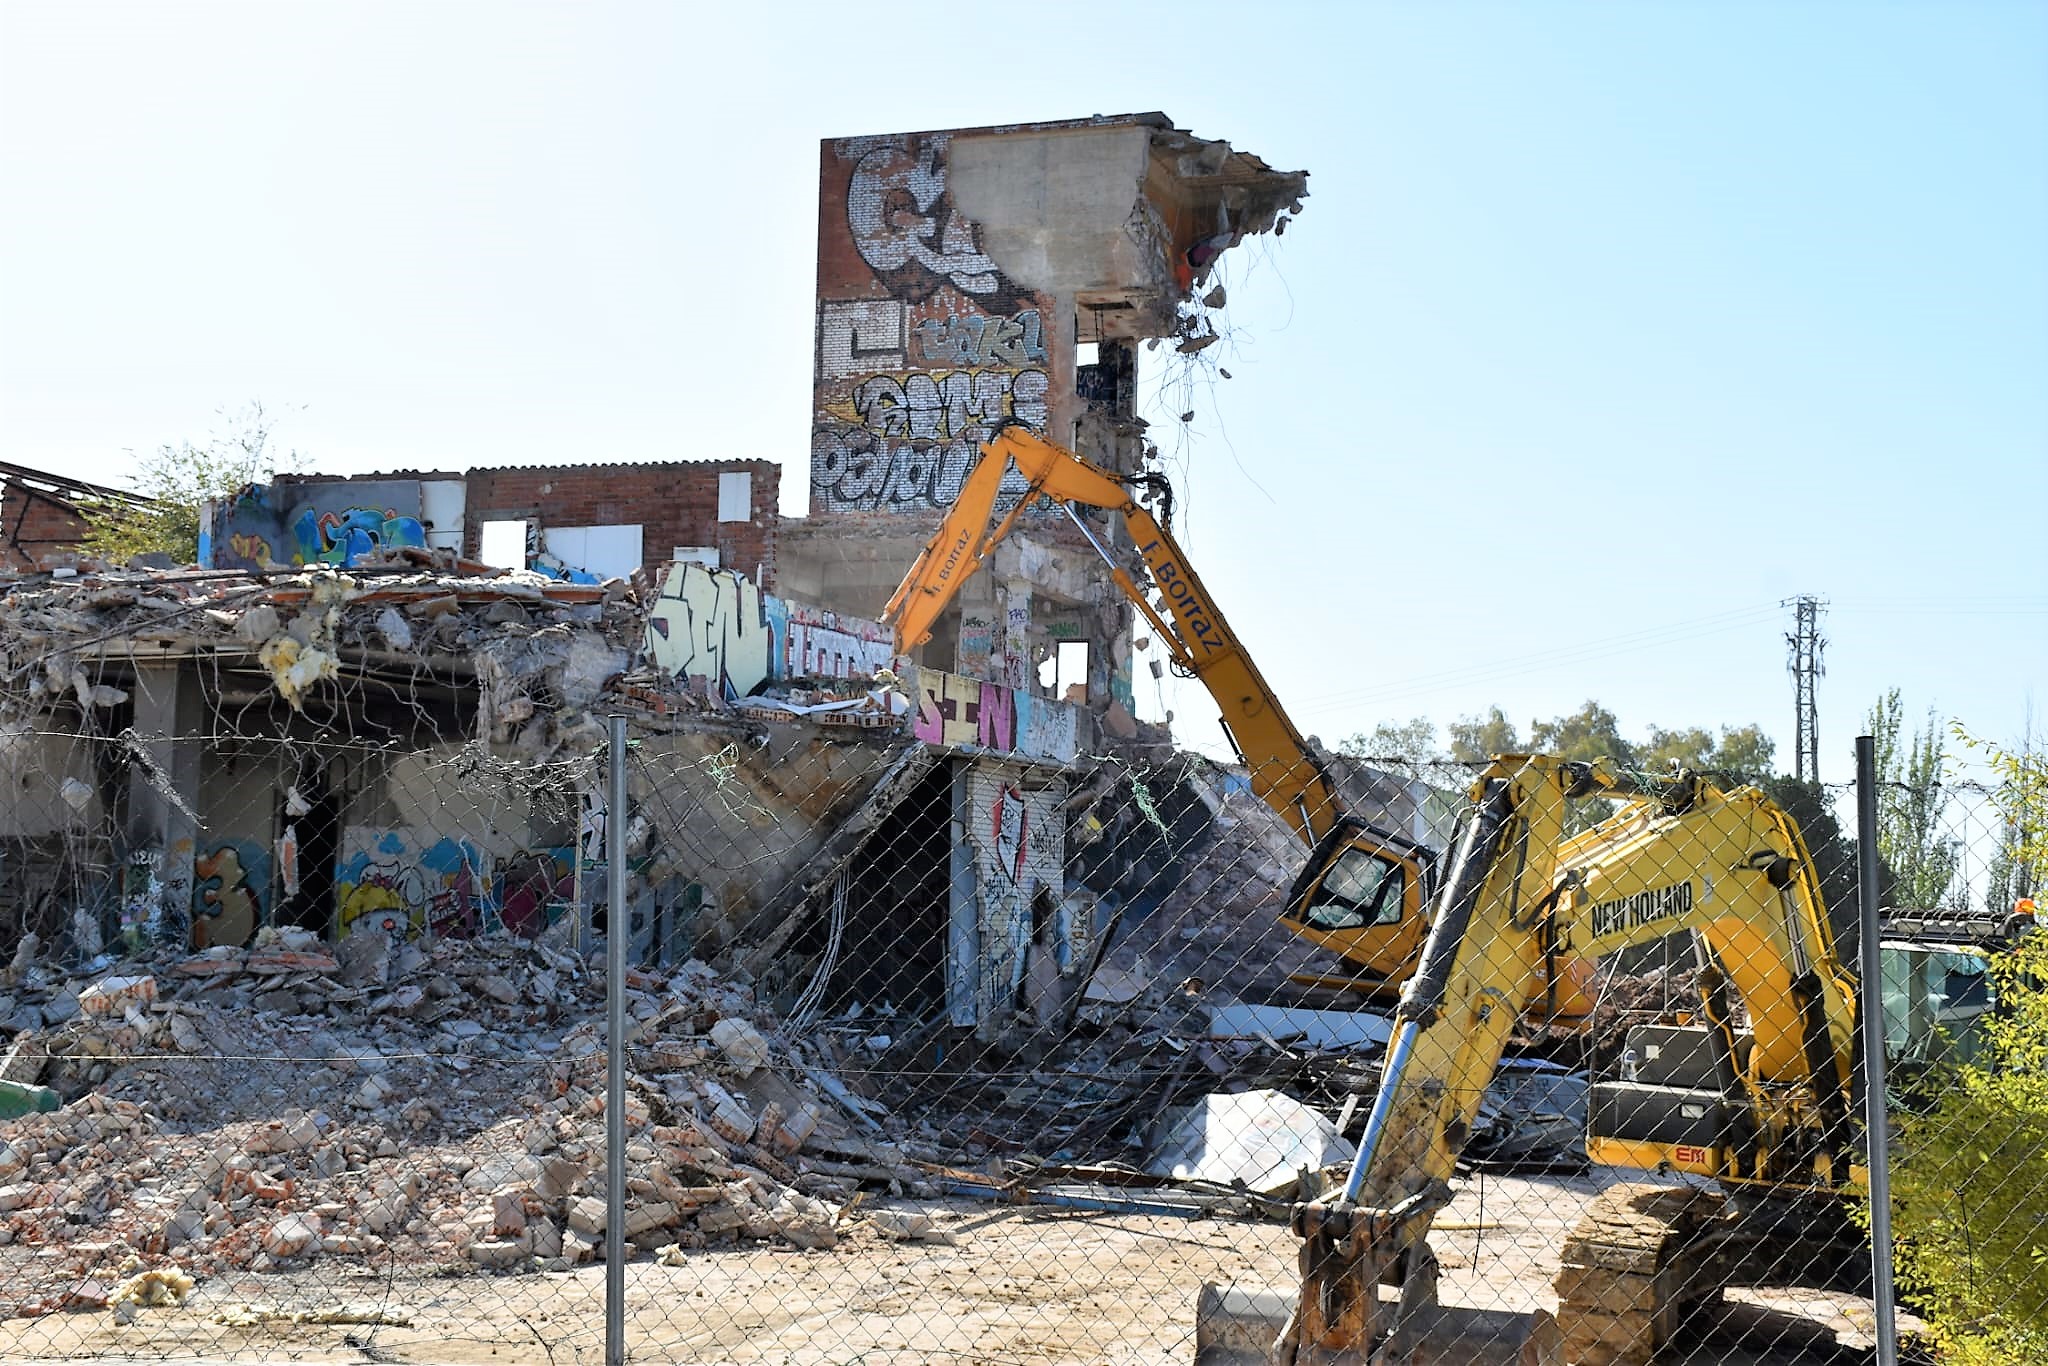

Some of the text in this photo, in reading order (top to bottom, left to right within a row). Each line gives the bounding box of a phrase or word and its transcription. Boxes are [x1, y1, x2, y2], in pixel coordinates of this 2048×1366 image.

[939, 528, 970, 580] Borraz
[1155, 561, 1224, 656] Borraz
[1591, 880, 1692, 939] NEW HOLLAND
